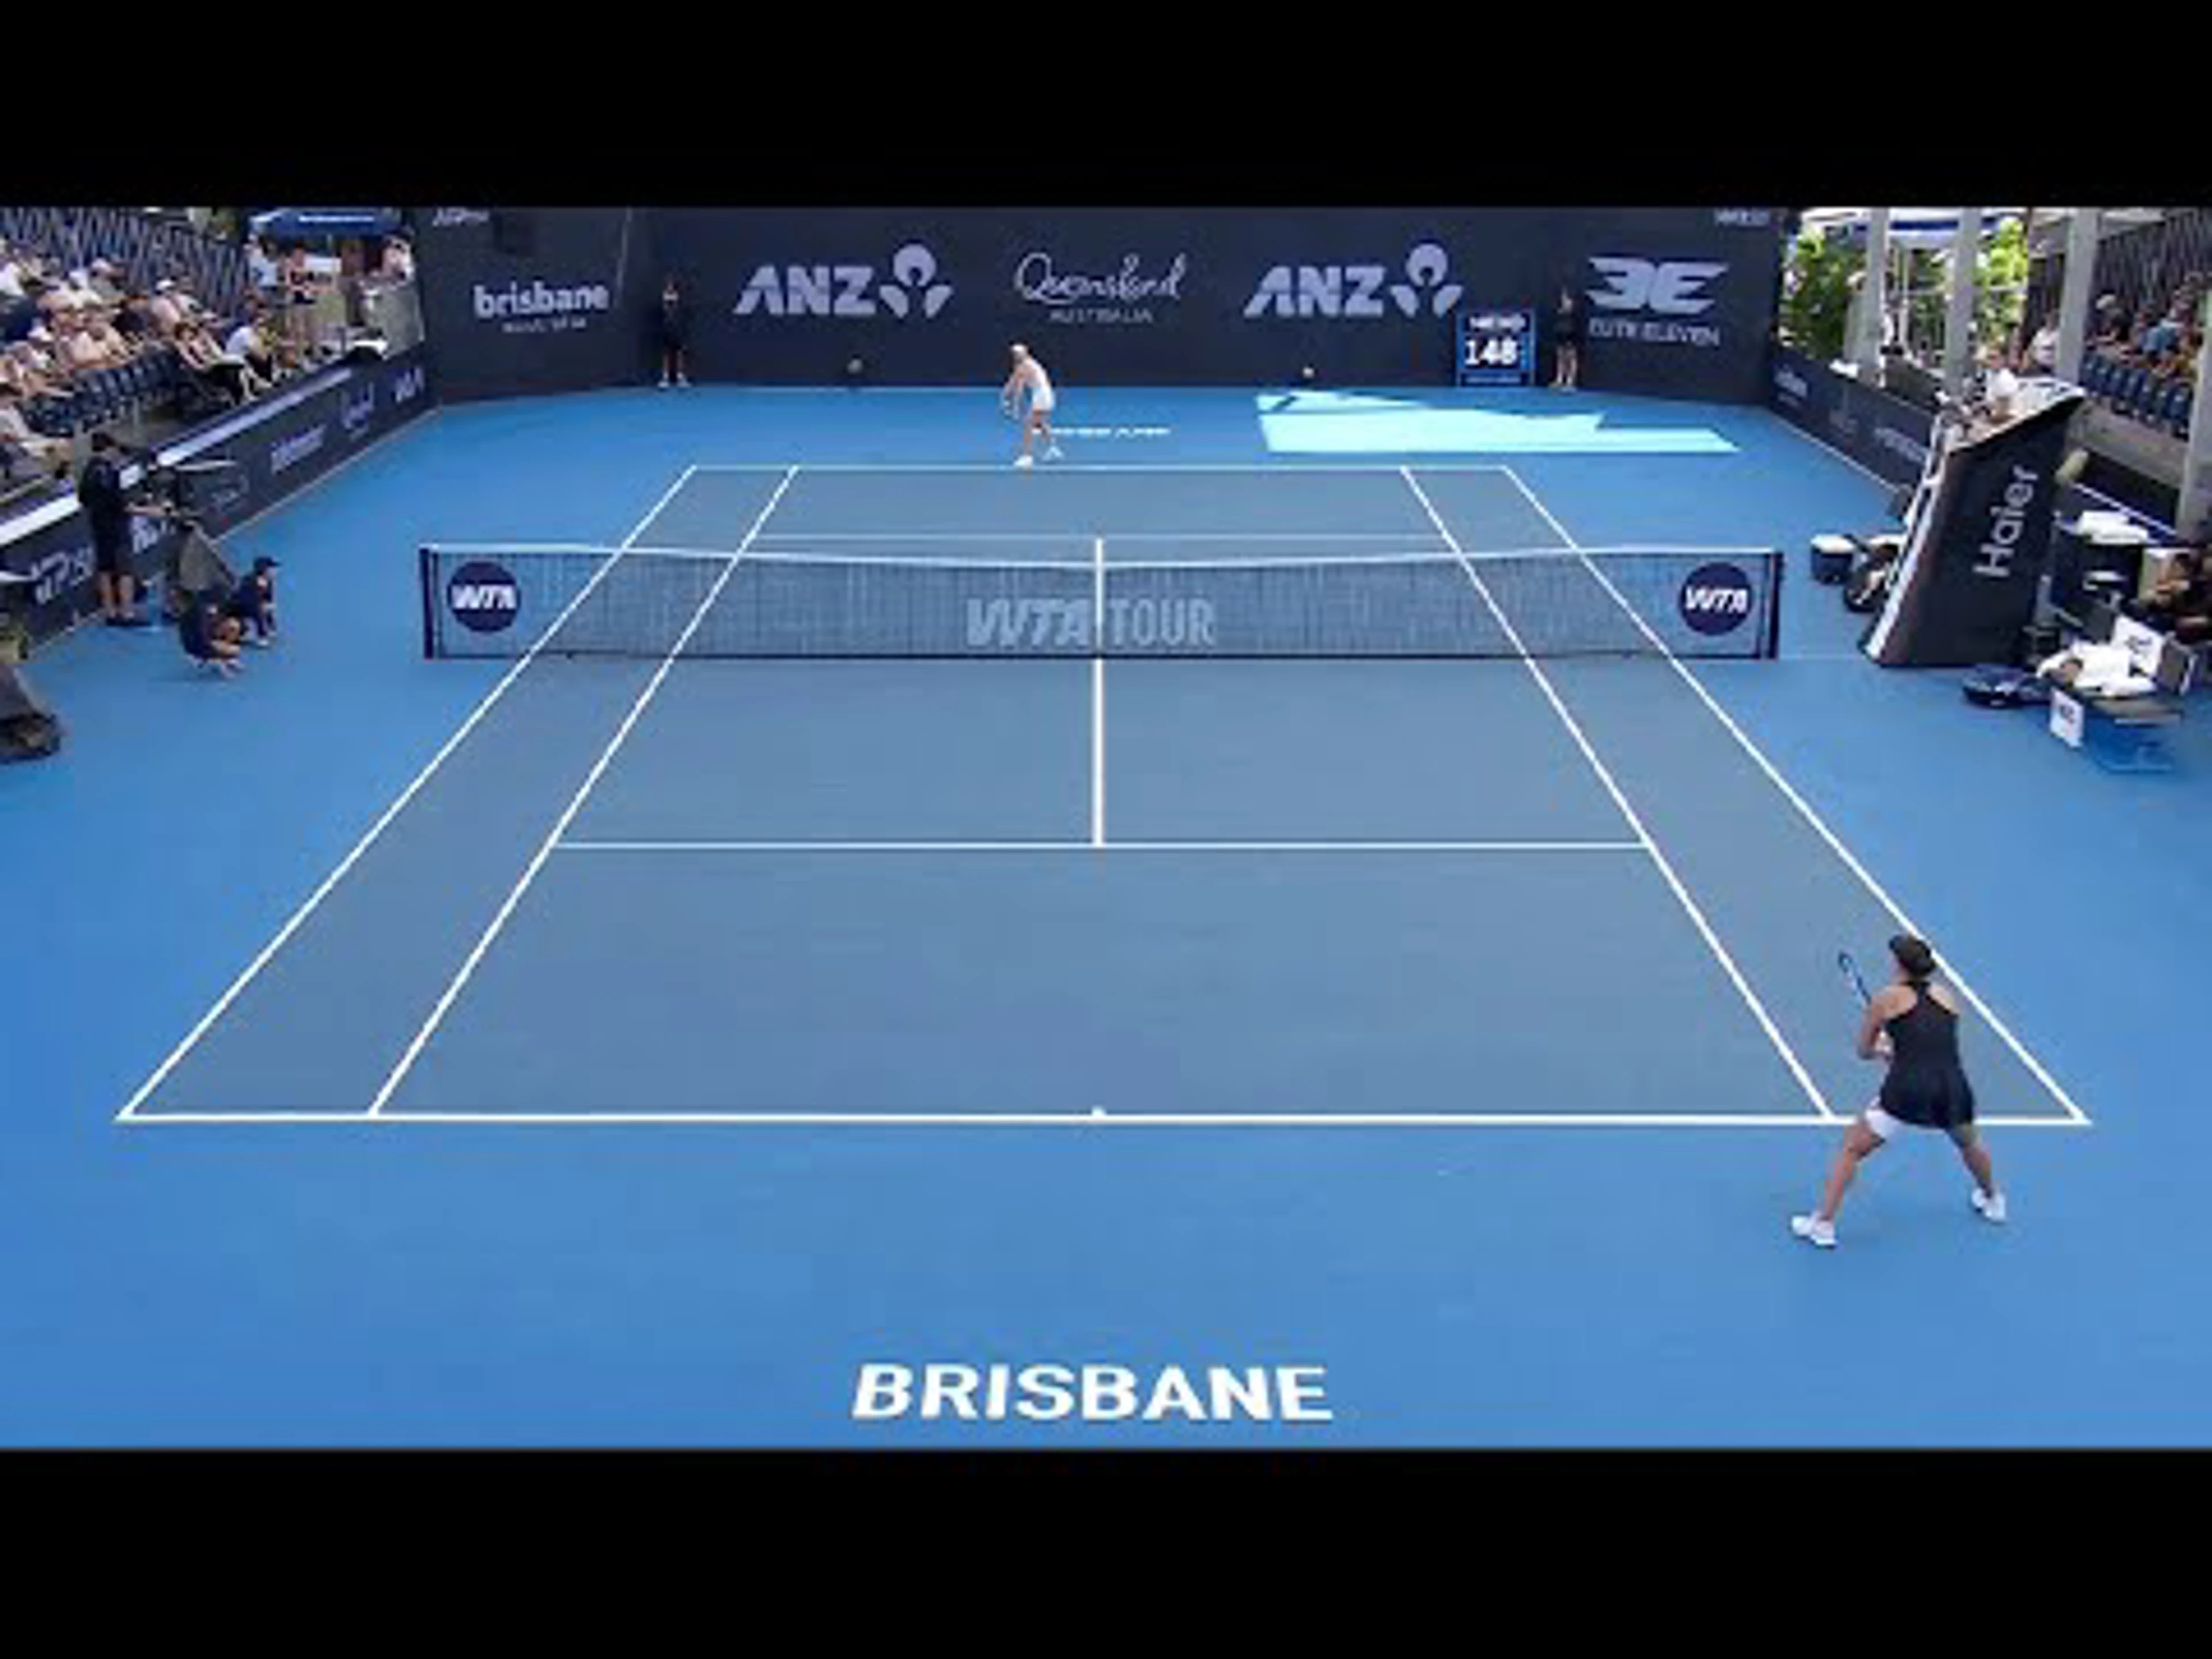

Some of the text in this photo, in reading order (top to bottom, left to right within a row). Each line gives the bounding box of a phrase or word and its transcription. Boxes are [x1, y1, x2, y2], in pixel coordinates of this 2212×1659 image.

[474, 281, 609, 319] brisbane
[732, 265, 876, 316] ANZ
[1014, 252, 1185, 305] Queensland
[1243, 265, 1387, 317] ANZ
[1465, 336, 1518, 365] 148
[1972, 464, 2038, 577] Haier
[451, 584, 517, 609] WTA
[965, 597, 1217, 646] WTA TOUR
[1685, 586, 1748, 613] WTA
[851, 1362, 1334, 1421] BRISBANE
